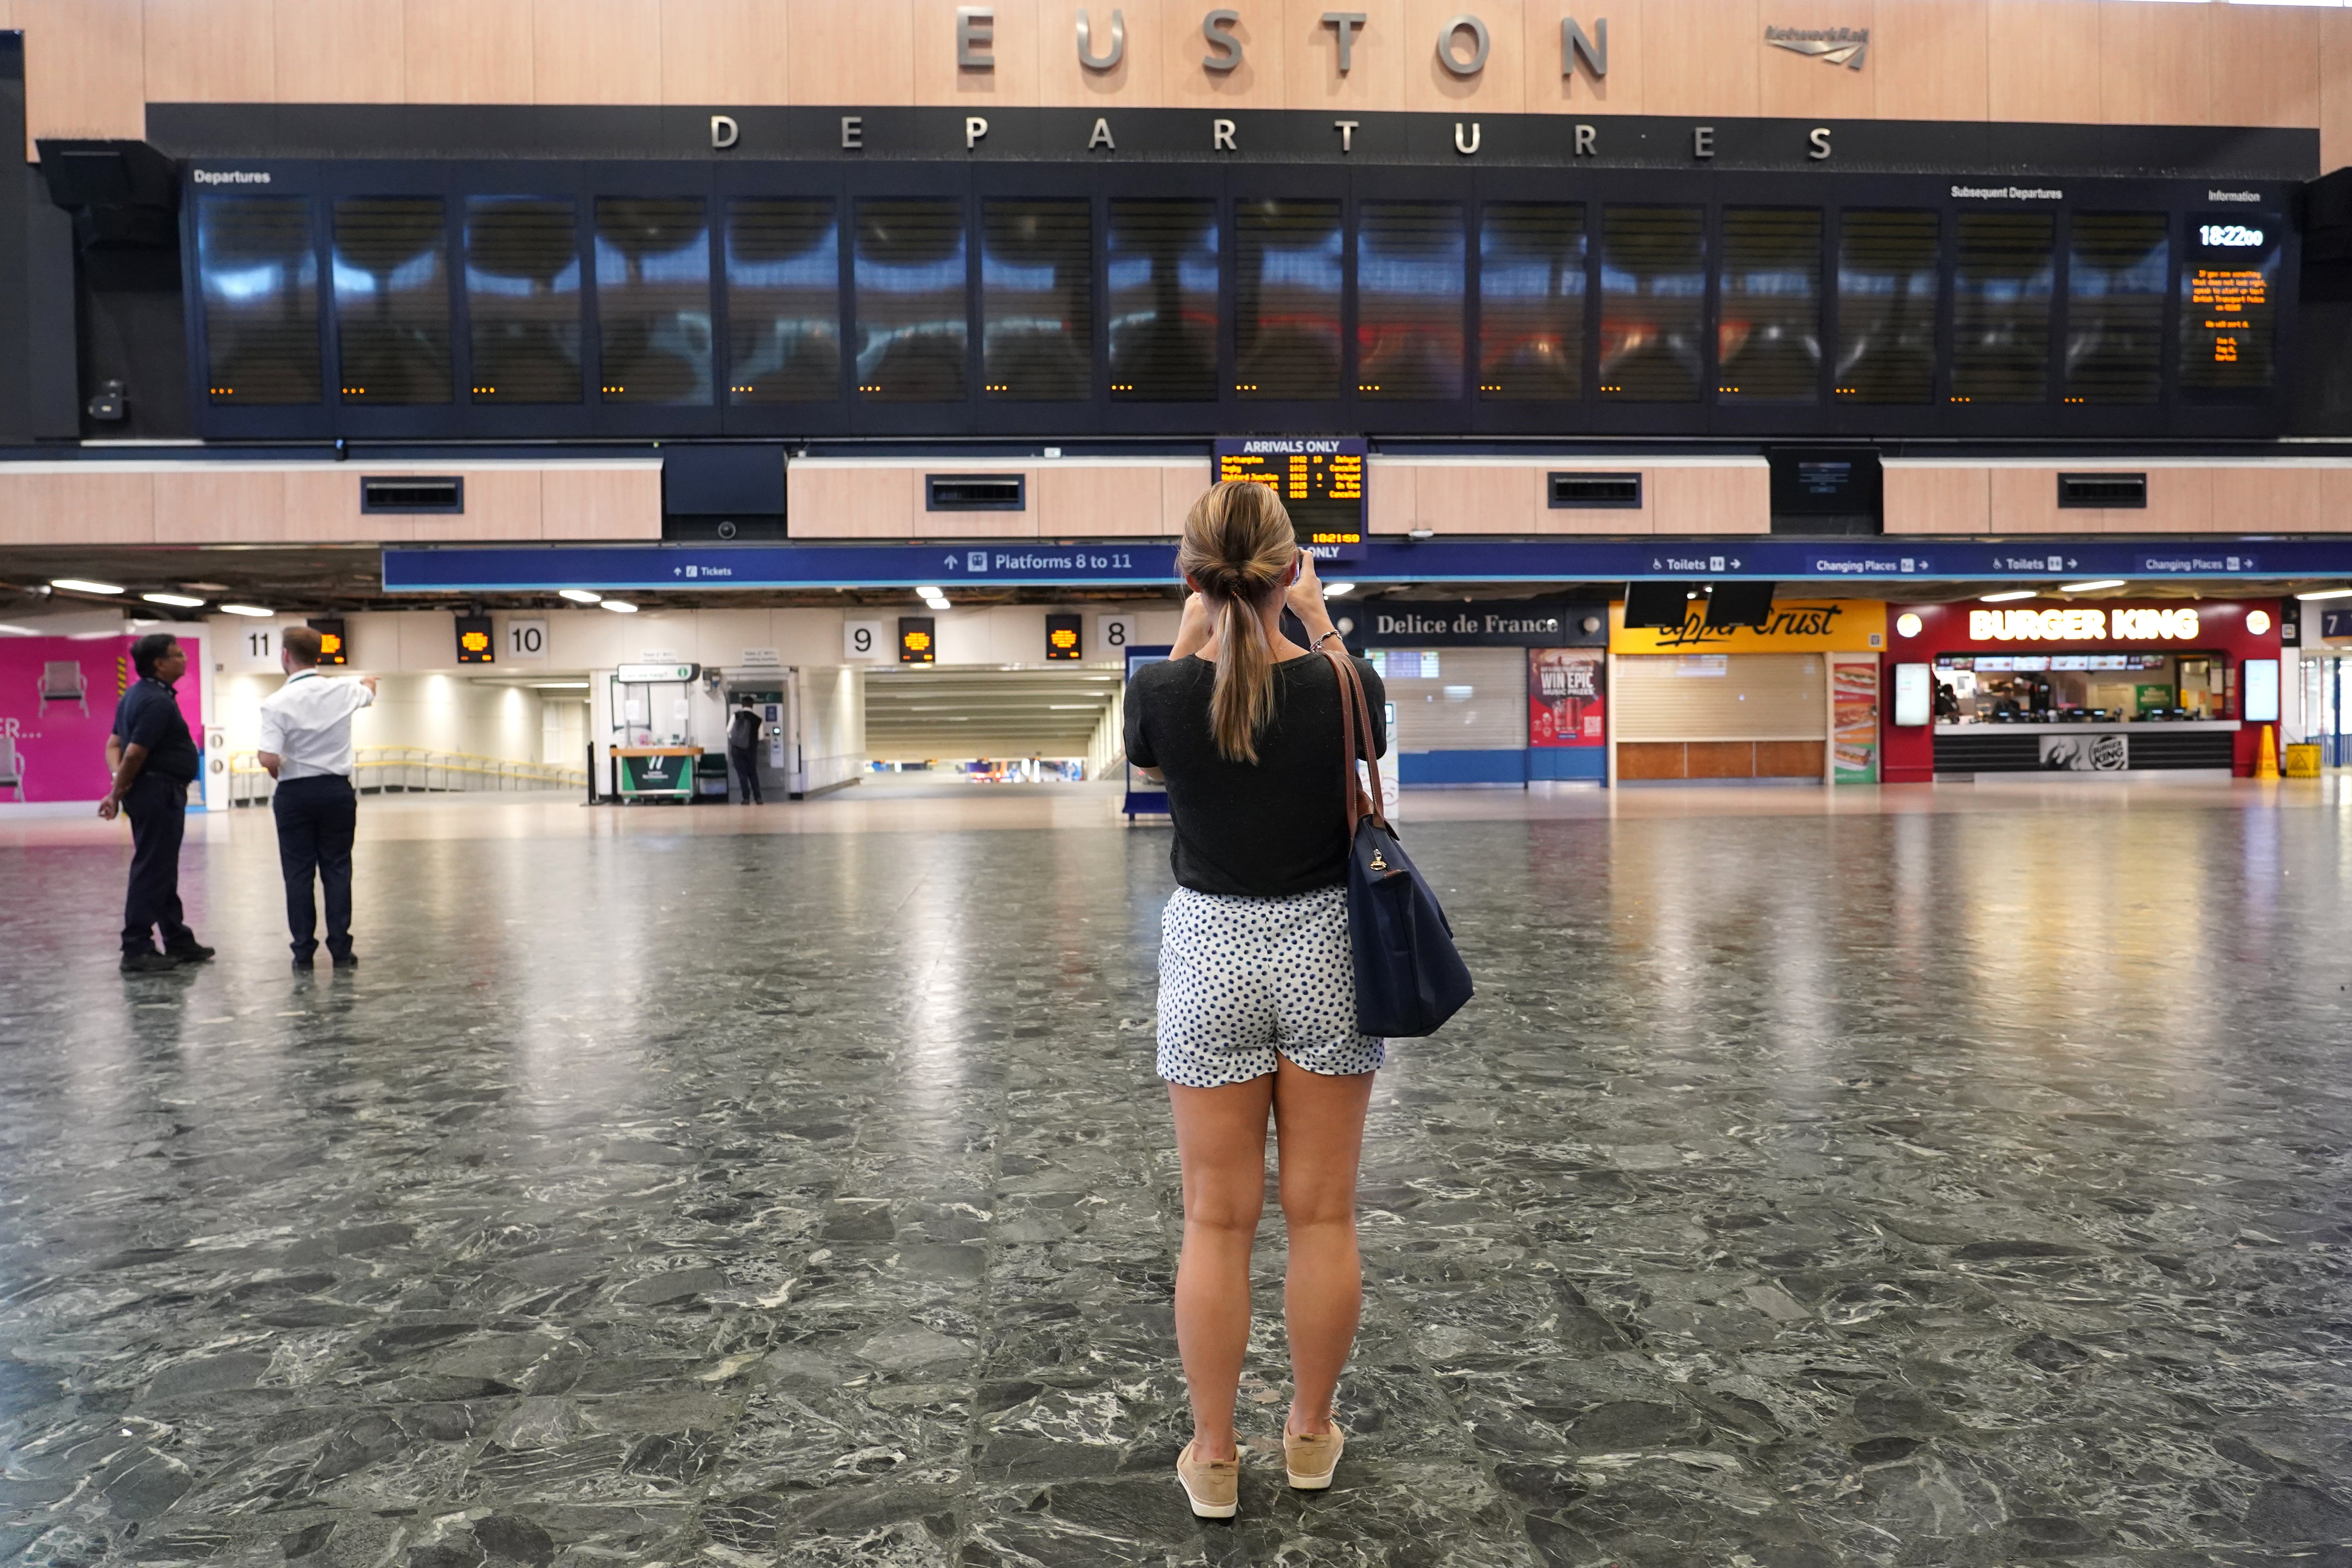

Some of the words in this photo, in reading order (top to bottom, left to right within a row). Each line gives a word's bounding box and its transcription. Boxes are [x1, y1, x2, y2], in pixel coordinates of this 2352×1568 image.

[956, 5, 1610, 78] EUSTON
[710, 114, 1833, 162] DEPARTURES
[193, 169, 271, 185] Departures
[1951, 185, 2007, 200] Subsequent
[2009, 187, 2063, 201] Departures
[2208, 189, 2261, 202] Information
[1244, 441, 1303, 453] ARRIVALS
[1306, 441, 1340, 453] ONLY
[995, 554, 1073, 570] Platforms
[1075, 554, 1087, 569] 8
[1090, 555, 1108, 569] to
[1112, 554, 1132, 568] 11
[1666, 558, 1706, 571] Toilets
[1816, 559, 1864, 573] Changing
[1865, 560, 1897, 572] Places
[2006, 558, 2044, 570] Toilets
[2145, 559, 2191, 571] Changing
[2192, 559, 2223, 570] Places
[701, 566, 731, 577] Tickets
[1377, 613, 1447, 634] Delice
[1452, 613, 1478, 633] de
[1484, 614, 1559, 633] France
[1969, 609, 2107, 641] BURGER
[2111, 608, 2199, 640] KING
[2327, 615, 2338, 635] 7
[512, 628, 542, 652] 10
[854, 628, 872, 653] 9
[1107, 622, 1126, 646] 8
[249, 633, 269, 656] 11
[1540, 672, 1566, 689] WIN
[1566, 672, 1594, 689] EPIC
